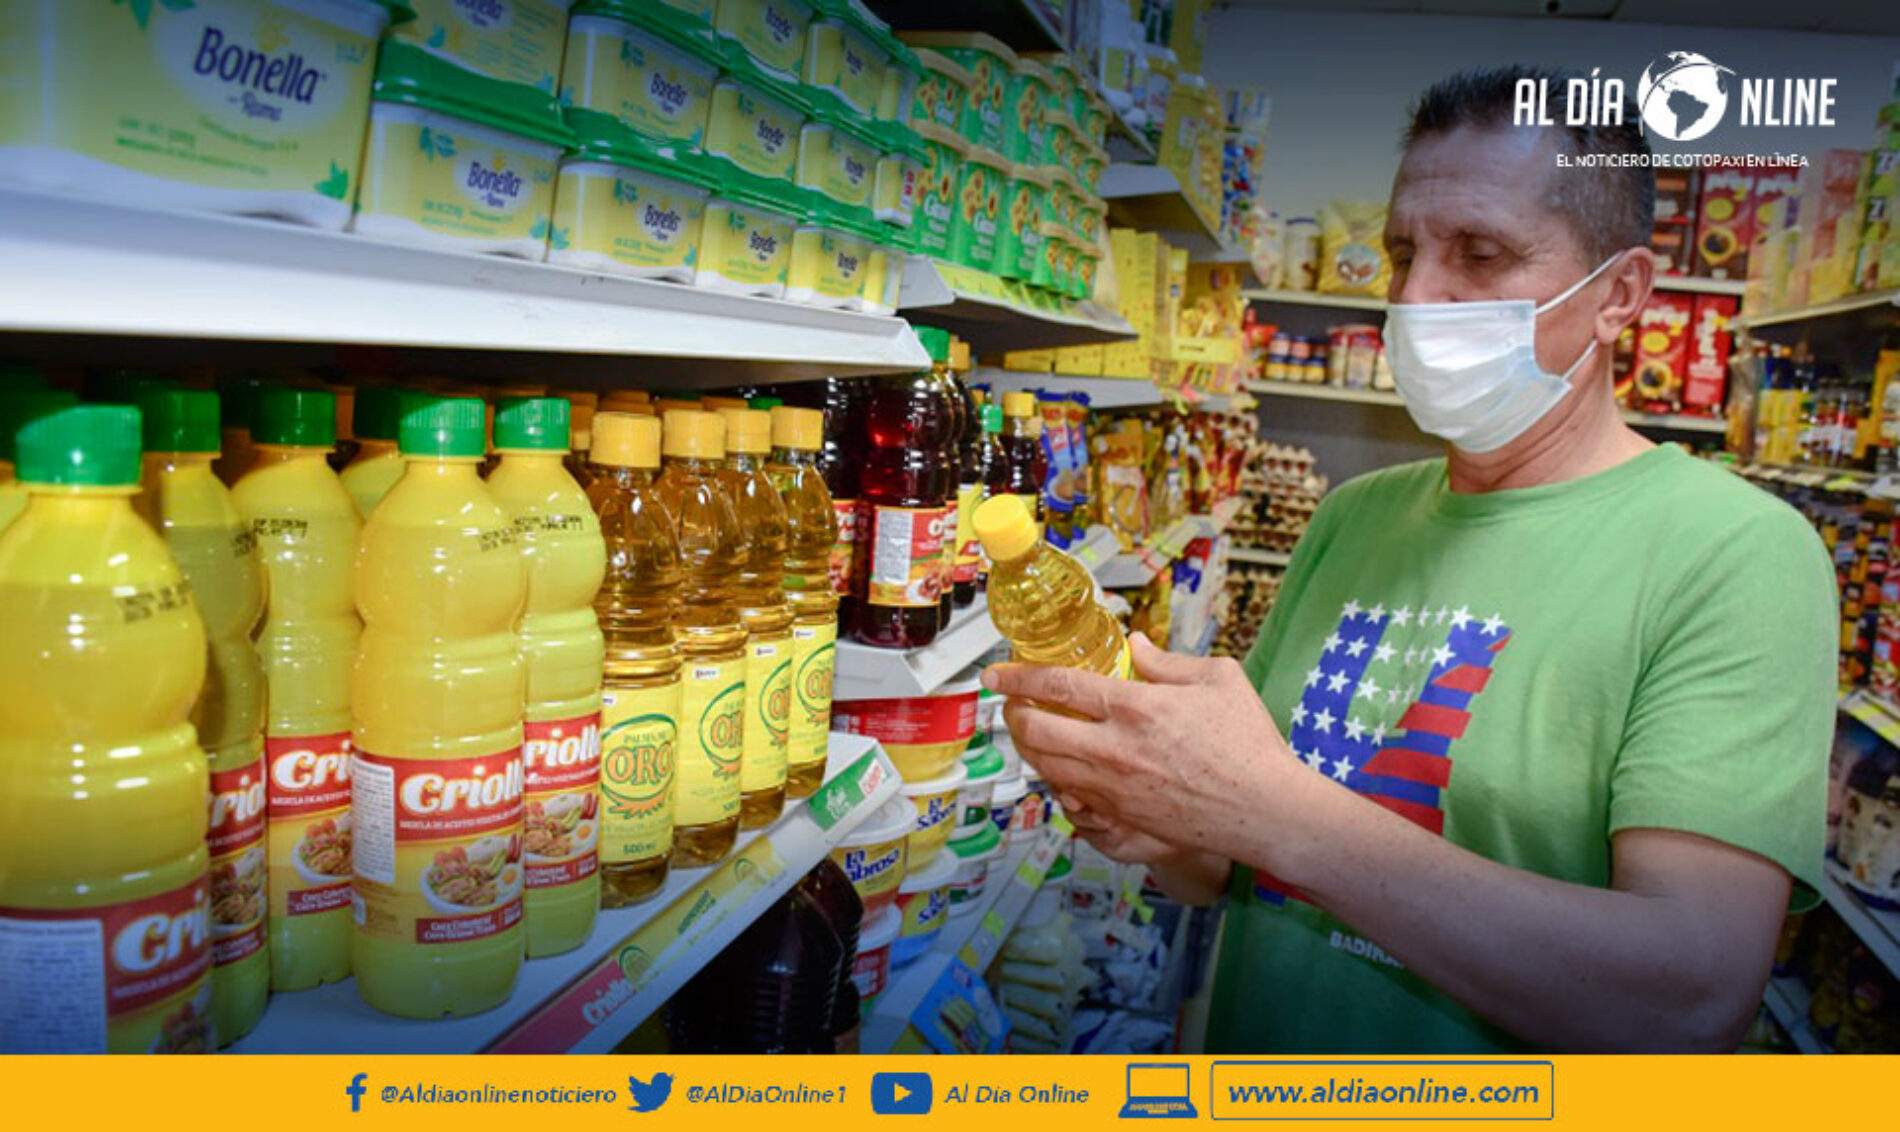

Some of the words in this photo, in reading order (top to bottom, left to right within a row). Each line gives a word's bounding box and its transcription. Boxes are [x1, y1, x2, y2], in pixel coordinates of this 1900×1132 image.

[194, 25, 317, 104] Bonella
[467, 161, 521, 197] Bonella
[605, 742, 674, 786] ORO
